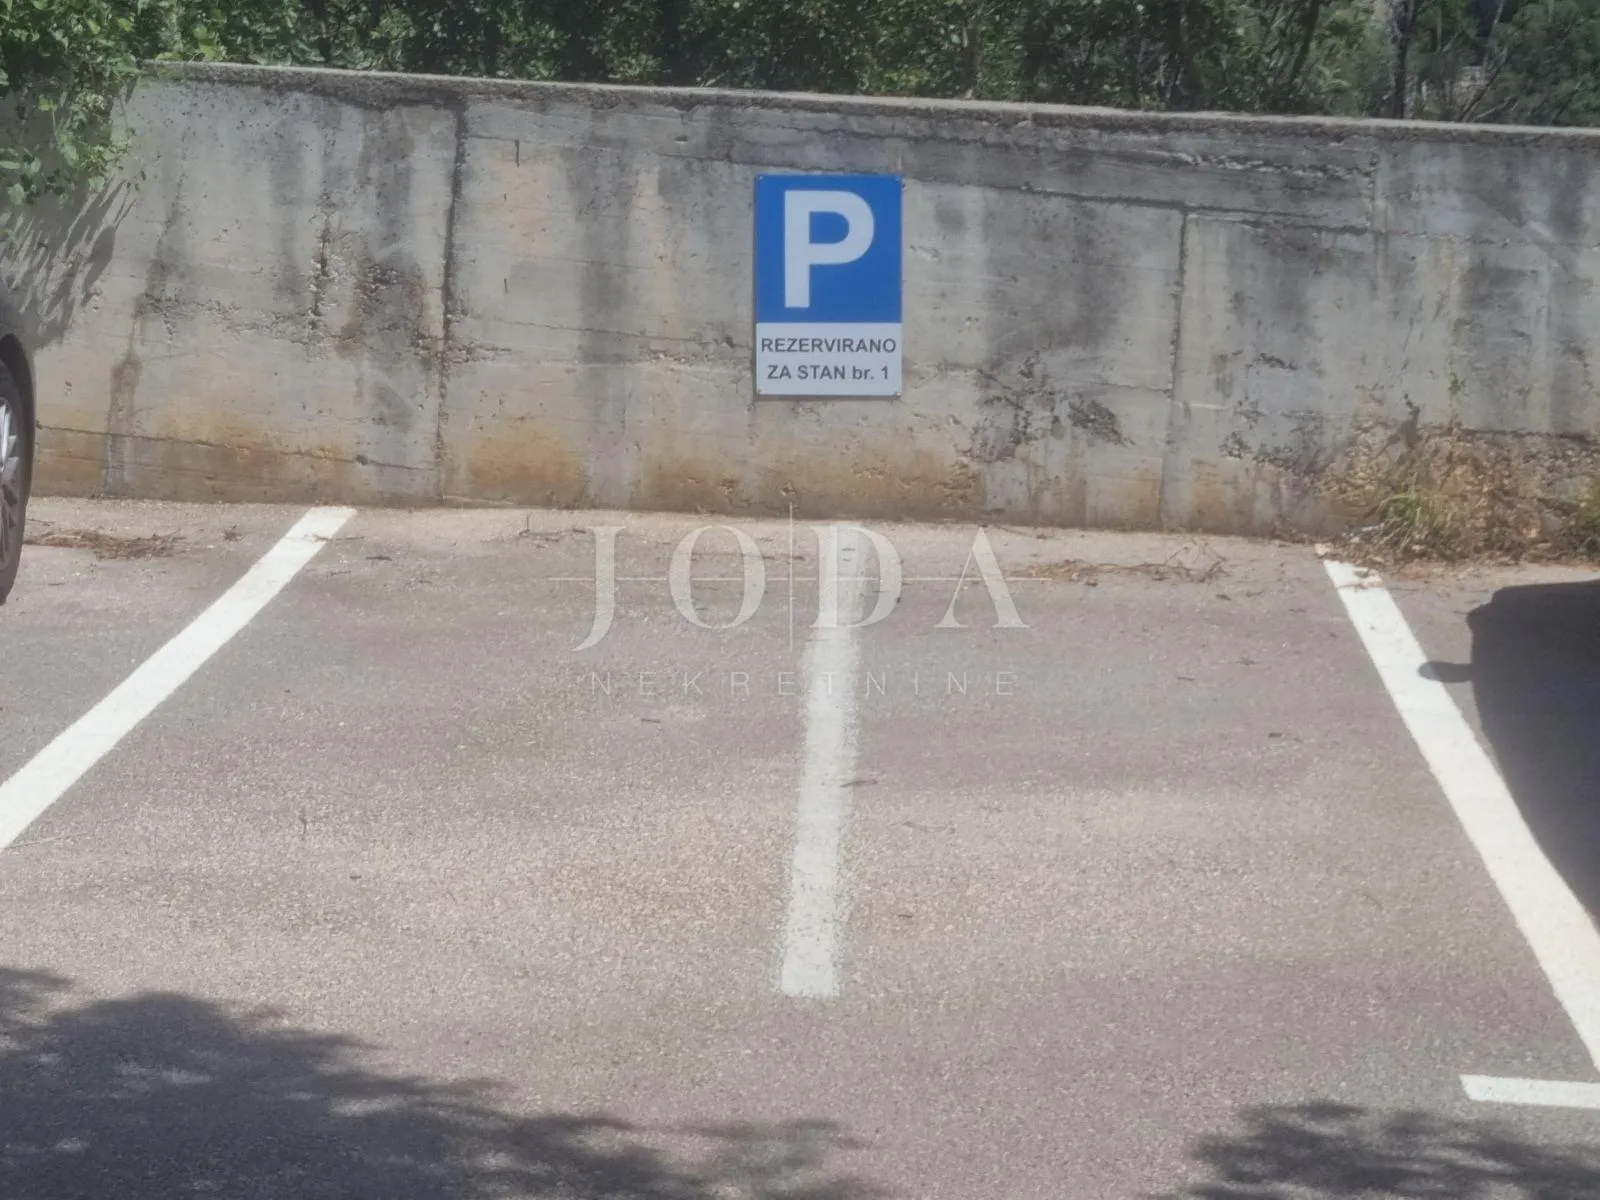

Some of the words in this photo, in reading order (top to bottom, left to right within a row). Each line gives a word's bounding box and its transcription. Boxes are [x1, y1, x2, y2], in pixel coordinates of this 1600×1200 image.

[784, 189, 875, 308] P
[761, 337, 897, 354] REZERVIRANO
[766, 364, 792, 380] ZA
[797, 364, 846, 380] STAN
[852, 364, 874, 380] br.
[880, 364, 889, 380] 1
